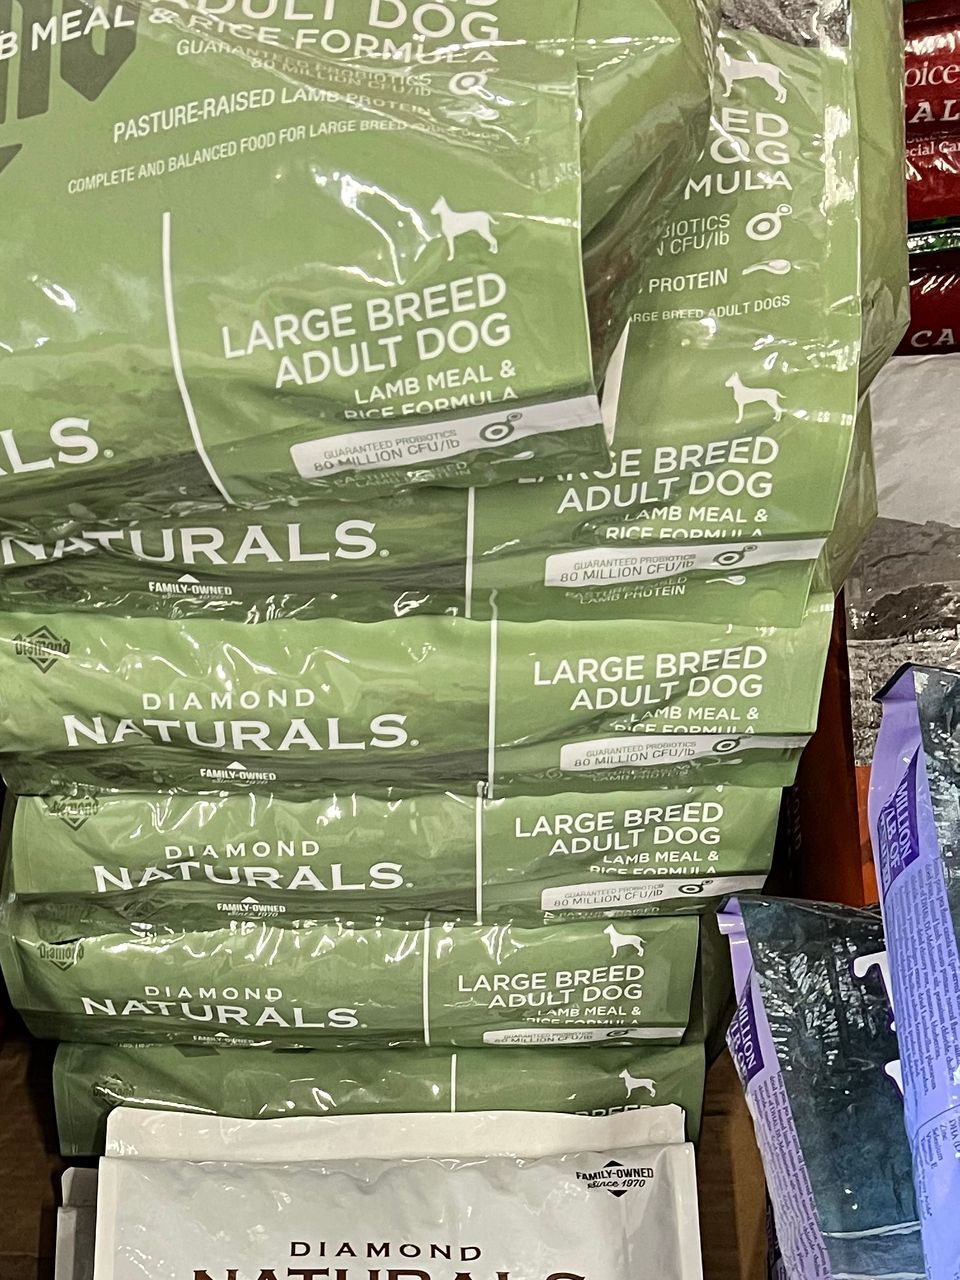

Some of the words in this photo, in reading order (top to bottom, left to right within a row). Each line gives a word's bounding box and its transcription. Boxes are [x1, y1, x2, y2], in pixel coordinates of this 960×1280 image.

[30, 4, 135, 53] MEAL
[295, 29, 498, 64] FORMULA
[113, 88, 275, 143] PASTURE-RAISED
[68, 166, 135, 194] COMPLETE
[138, 160, 165, 178] AND
[169, 141, 237, 173] BALANCED
[240, 131, 276, 154] FOOD
[279, 127, 306, 146] FOR
[309, 120, 357, 139] LARGE
[360, 119, 408, 131] BREED
[649, 268, 728, 293] PROTEIN
[221, 304, 356, 359] LARGE
[366, 272, 507, 331] BREED
[708, 303, 751, 318] ADULT
[755, 295, 791, 312] DOGS
[275, 335, 402, 388] ADULT
[416, 312, 512, 360] DOG
[353, 375, 420, 405] LAMB
[426, 365, 493, 397] MEAL
[500, 360, 517, 377] &
[401, 387, 519, 415] FORMULA
[338, 450, 403, 467] MILLION
[654, 436, 780, 475] BREED
[557, 477, 680, 514] ADULT
[689, 469, 773, 498] DOG
[624, 506, 682, 522] LAMB
[688, 507, 747, 523] MEAL
[754, 508, 768, 522] &
[1, 519, 378, 566] NATURALS
[583, 566, 642, 581] MILLION
[148, 581, 233, 596] FAMILY-OWNED
[534, 655, 644, 686] LARGE
[655, 645, 767, 677] BREED
[142, 688, 316, 711] DIAMOND
[570, 681, 680, 711] ADULT
[687, 674, 763, 698] DOG
[631, 706, 682, 722] LAMB
[688, 707, 741, 720] MEAL
[747, 707, 759, 719] &
[62, 714, 409, 752] NATURALS
[200, 768, 277, 780] FAMILY-OWNED
[515, 812, 614, 838] LARGE
[623, 802, 724, 828] BREED
[896, 778, 913, 863] MILLION
[164, 840, 321, 860] DIAMOND
[549, 829, 643, 856] ADULT
[653, 825, 721, 845] DOG
[603, 852, 650, 864] LAMB
[655, 851, 702, 862] MEAL
[93, 863, 405, 892] NATURALS
[217, 903, 287, 913] FAMILY-OWNED
[458, 972, 548, 992] LARGE
[555, 965, 645, 988] BREED
[144, 985, 284, 1001] DIAMOND
[488, 989, 575, 1009] ADULT
[583, 984, 643, 1002] DOG
[80, 997, 360, 1028] NATURALS
[584, 1006, 627, 1016] MEAL
[576, 1168, 654, 1180] FAMILY-OWNED
[622, 1179, 645, 1187] 1970
[290, 1240, 482, 1261] DIAMOND
